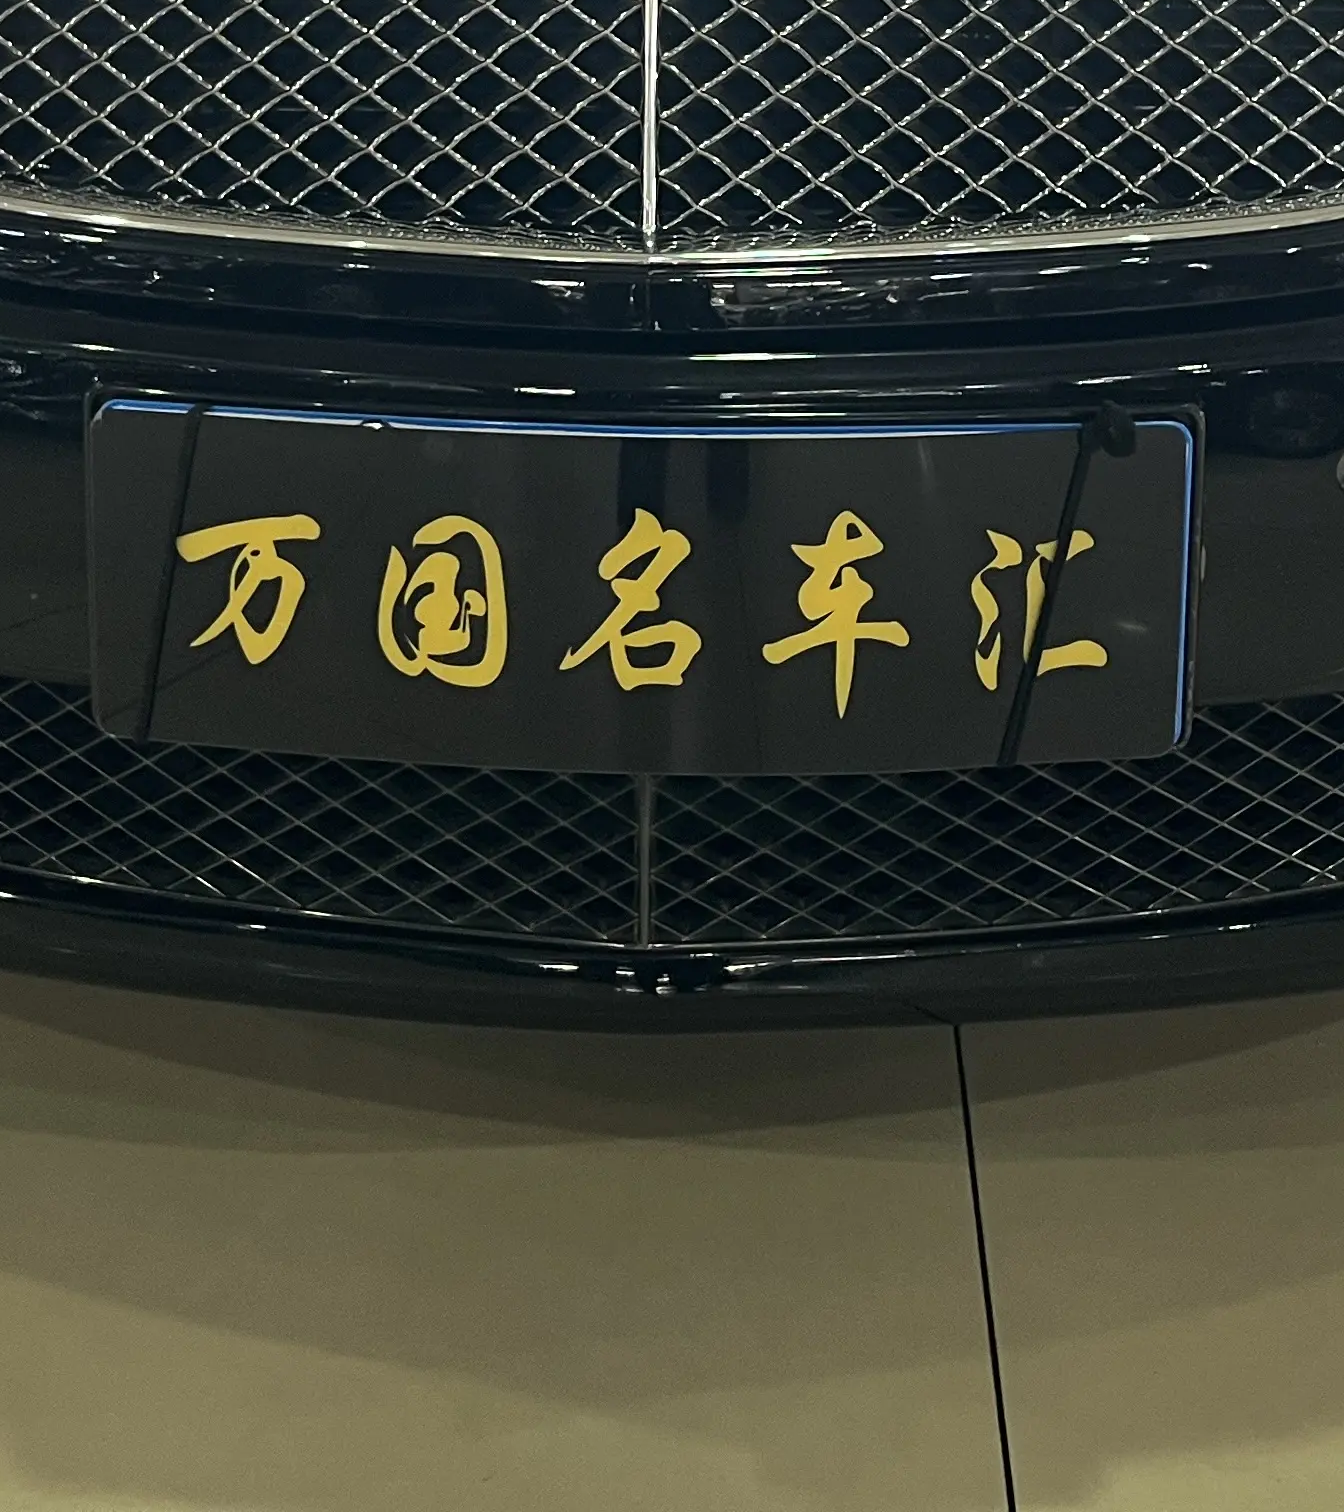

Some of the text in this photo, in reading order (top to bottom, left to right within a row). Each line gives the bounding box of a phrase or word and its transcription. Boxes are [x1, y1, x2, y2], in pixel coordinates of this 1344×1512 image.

[176, 506, 1108, 720] 万国名车汇
